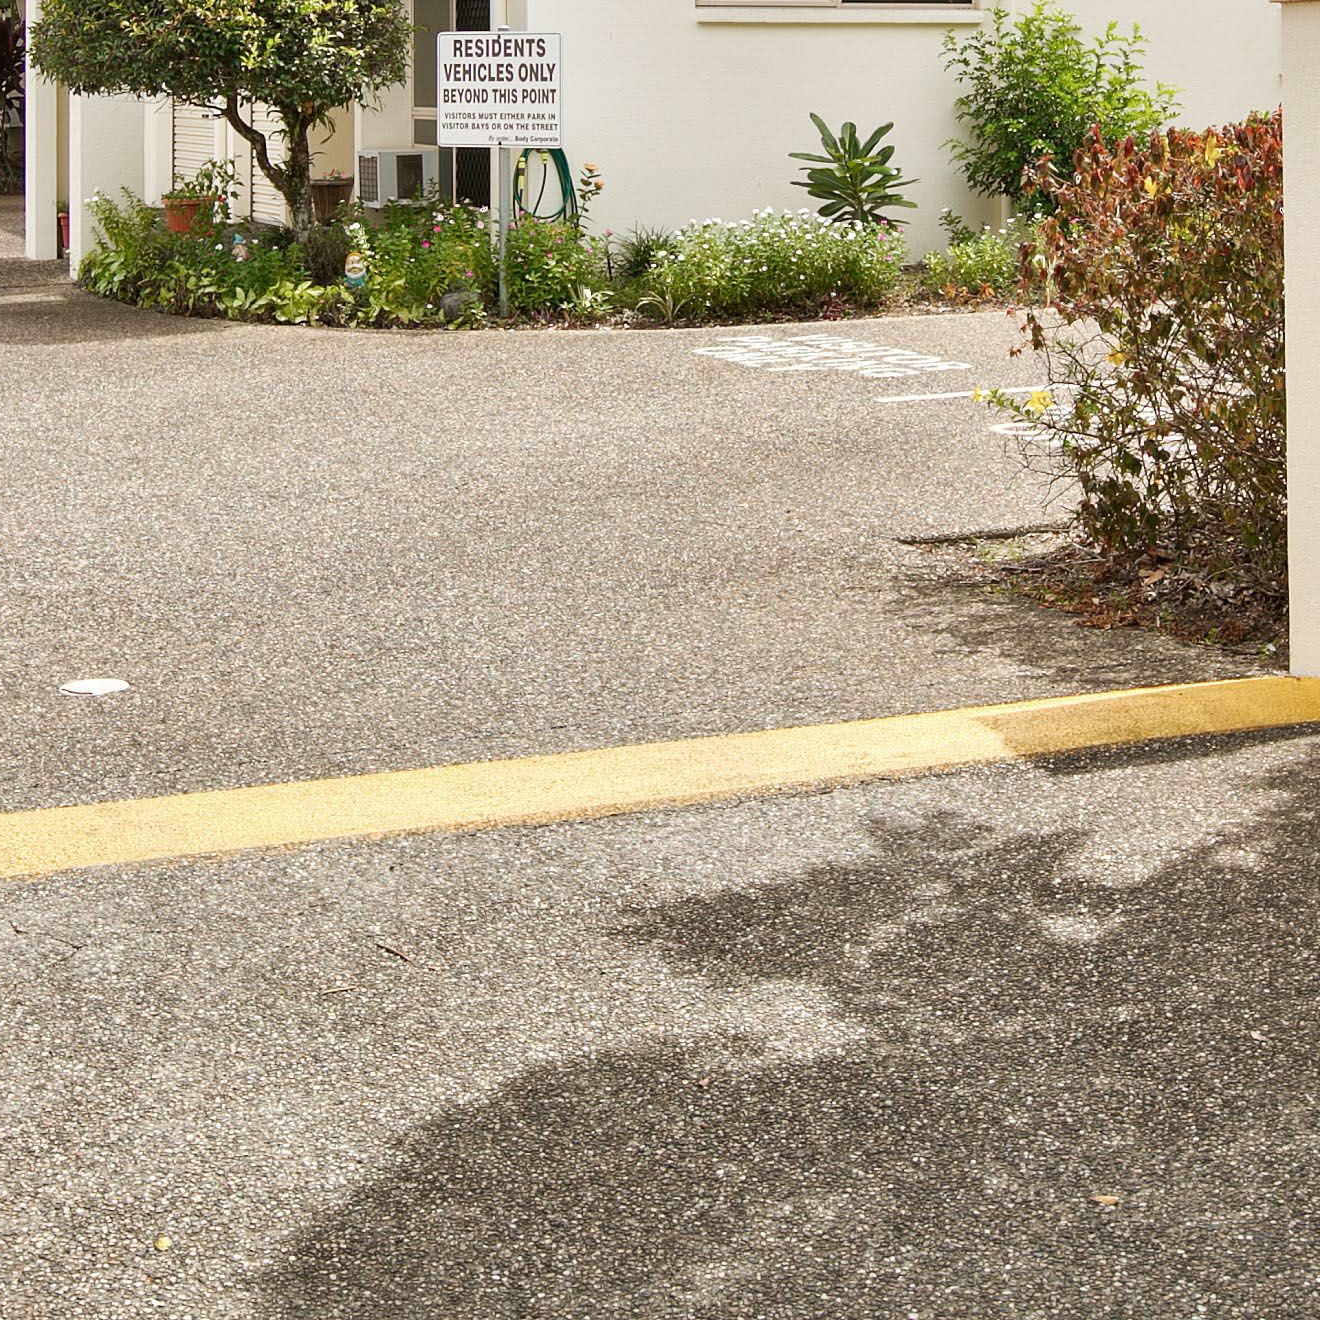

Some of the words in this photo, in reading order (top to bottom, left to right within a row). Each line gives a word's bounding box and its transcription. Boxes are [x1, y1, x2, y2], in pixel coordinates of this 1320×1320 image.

[453, 38, 546, 58] RESIDENTS
[443, 63, 514, 82] VEHICLES
[518, 63, 556, 82] ONLY
[443, 88, 489, 103] BEYOND
[492, 88, 518, 104] THIS
[521, 89, 557, 104] POINT
[444, 112, 476, 120] VISITORS
[478, 112, 497, 120] MUST
[442, 122, 469, 130] VISITOR
[471, 122, 490, 130] BAYS
[531, 123, 559, 131] STREET
[515, 135, 529, 143] Body
